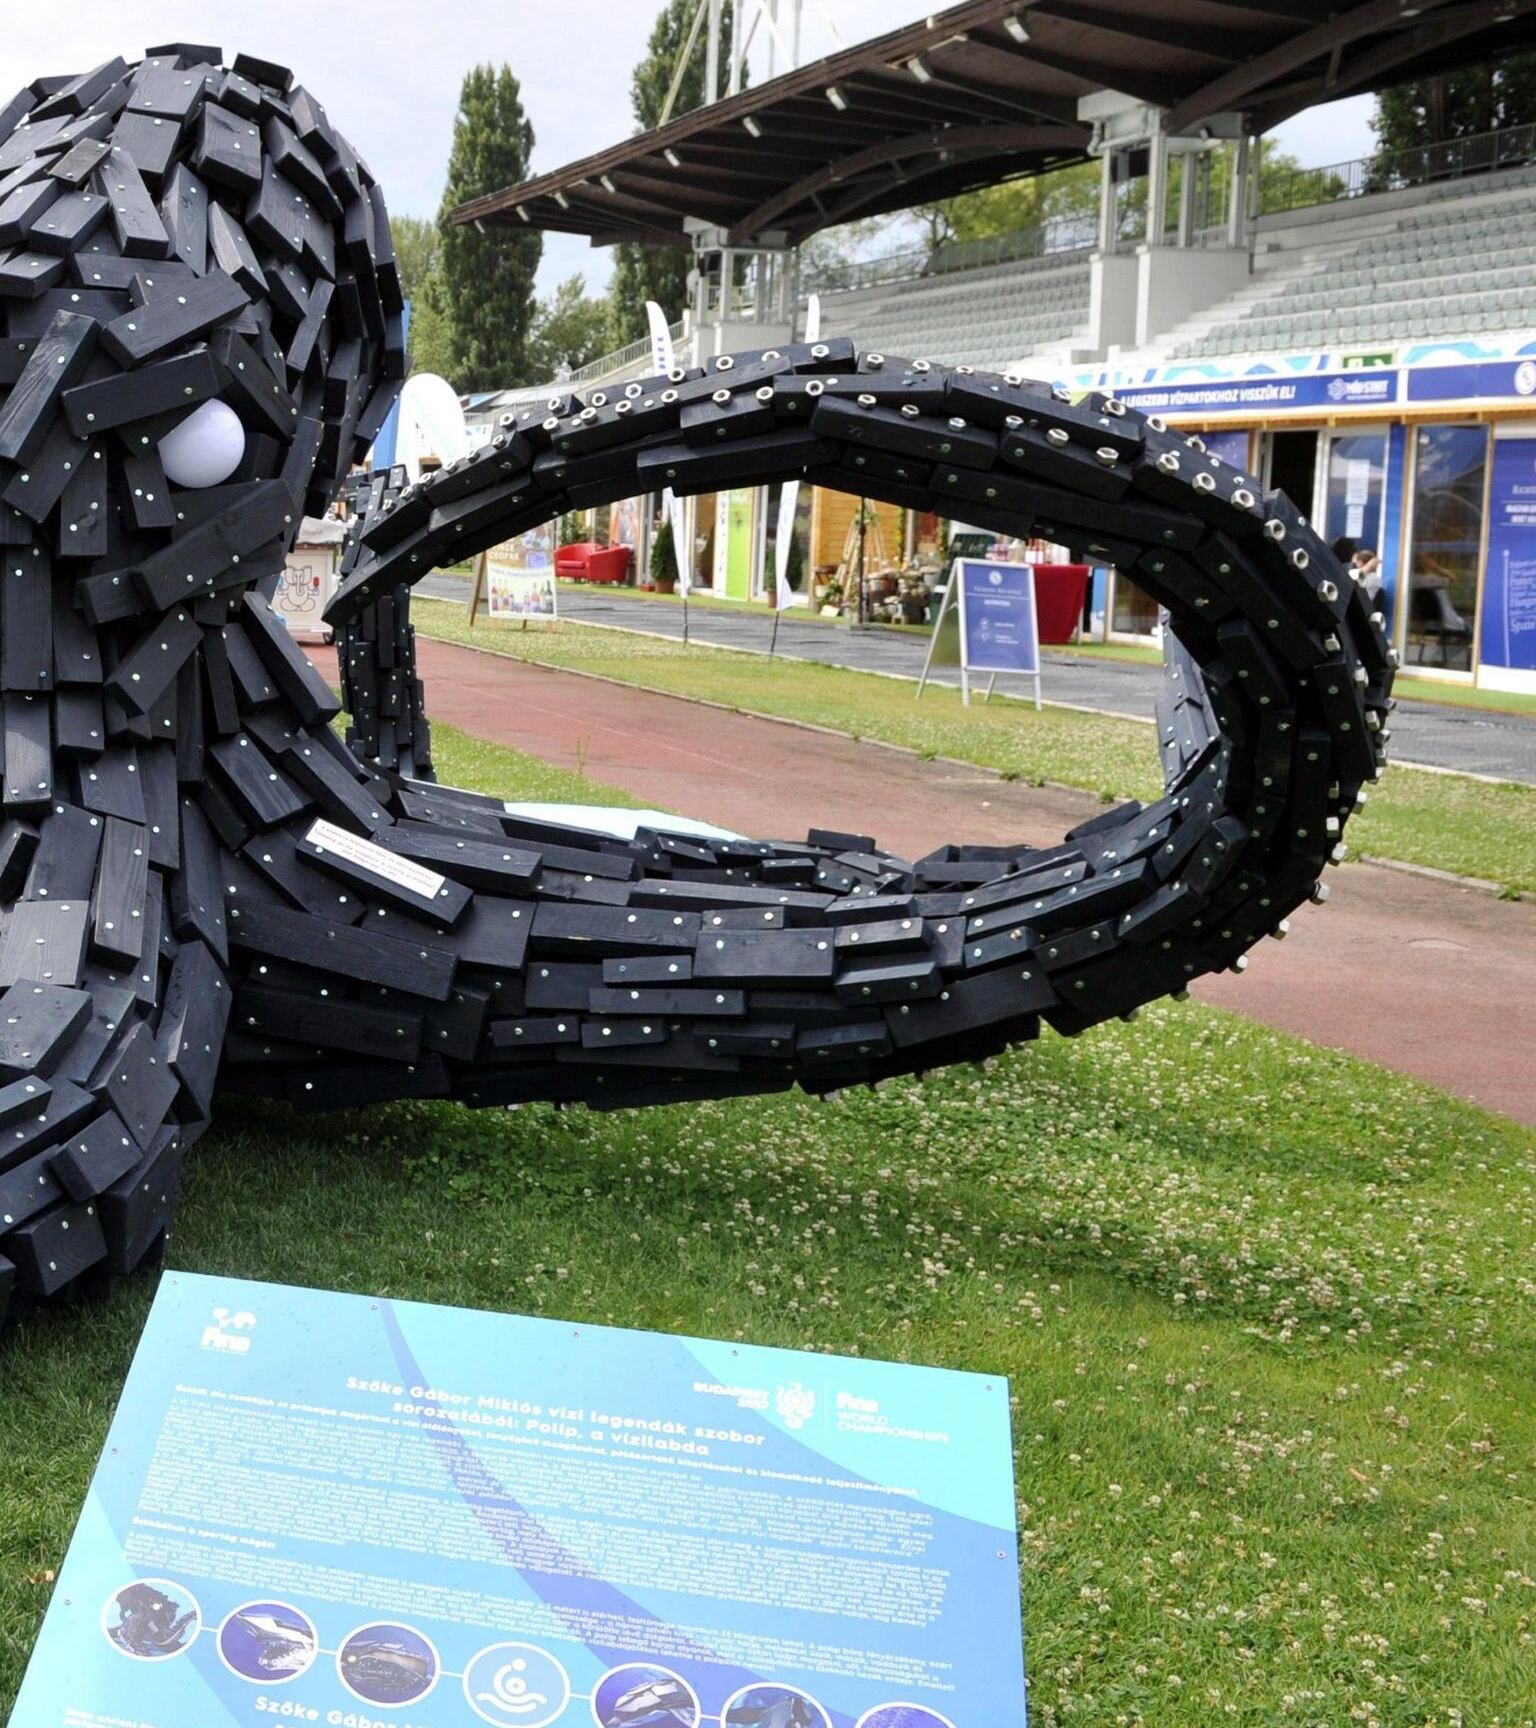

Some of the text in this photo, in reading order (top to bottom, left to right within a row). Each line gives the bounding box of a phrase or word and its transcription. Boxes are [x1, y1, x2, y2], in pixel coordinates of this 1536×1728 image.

[346, 1376, 766, 1446] Szőke Gábor Miklós vízi legendák szobor
[392, 1401, 518, 1428] sorozatából:
[590, 1430, 604, 1441] a
[611, 1432, 710, 1456] vízilabda
[255, 1696, 398, 1728] Szőke Gábor
